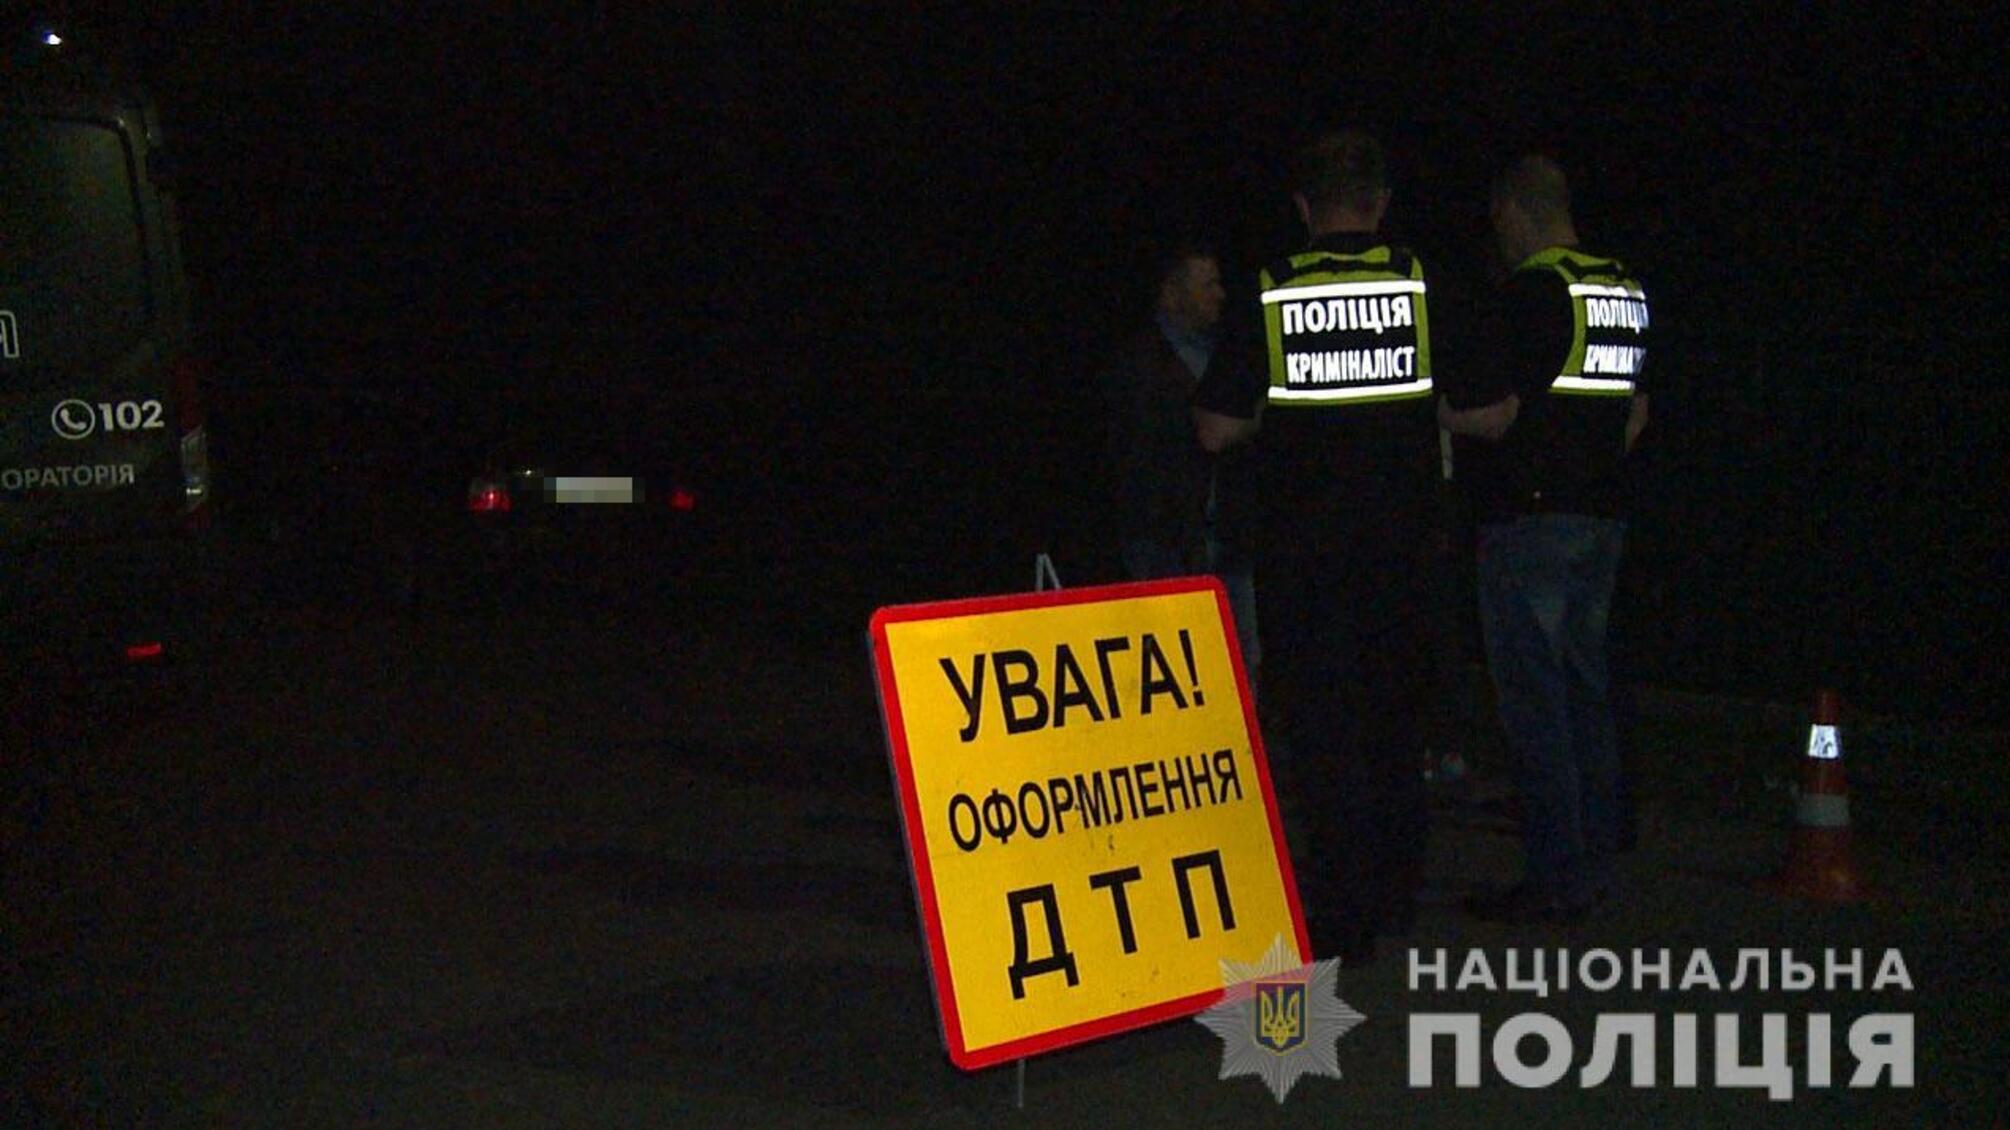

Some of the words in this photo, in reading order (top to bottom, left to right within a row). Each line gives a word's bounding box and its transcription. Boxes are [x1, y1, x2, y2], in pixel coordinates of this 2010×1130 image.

[1282, 296, 1412, 335] ПОЛІЦІЯ
[1286, 346, 1416, 384] КРИМІНАЛІСТ
[98, 400, 165, 431] 102
[939, 629, 1205, 743] УВАГА!
[948, 749, 1243, 852] ОФОРМЛЕННЯ
